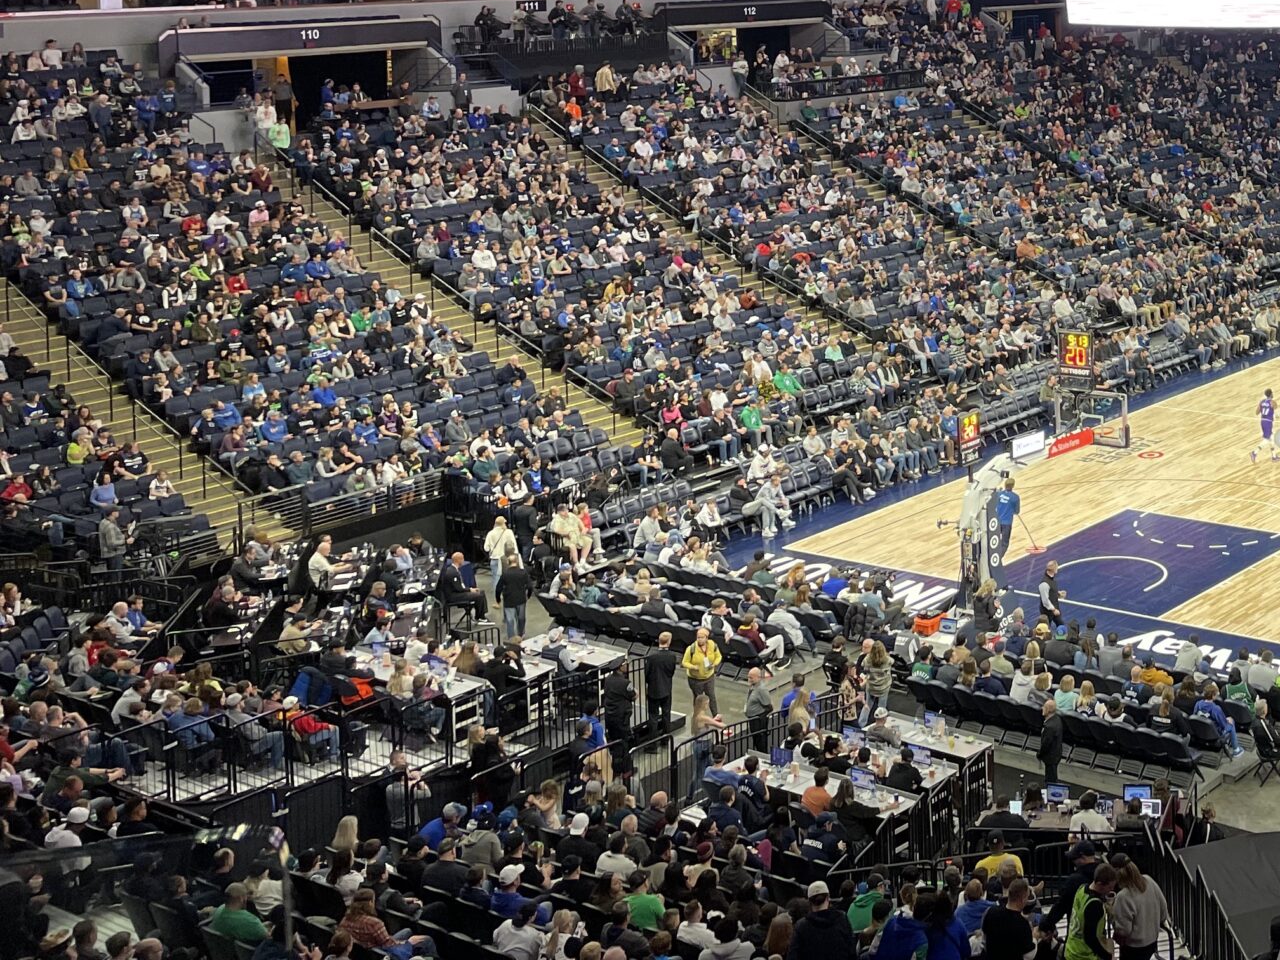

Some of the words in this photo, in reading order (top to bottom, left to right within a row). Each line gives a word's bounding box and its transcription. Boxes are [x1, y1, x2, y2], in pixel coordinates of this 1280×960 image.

[743, 7, 757, 16] 112
[300, 29, 320, 40] 110
[1067, 334, 1089, 346] 9:13
[1065, 346, 1086, 366] 20
